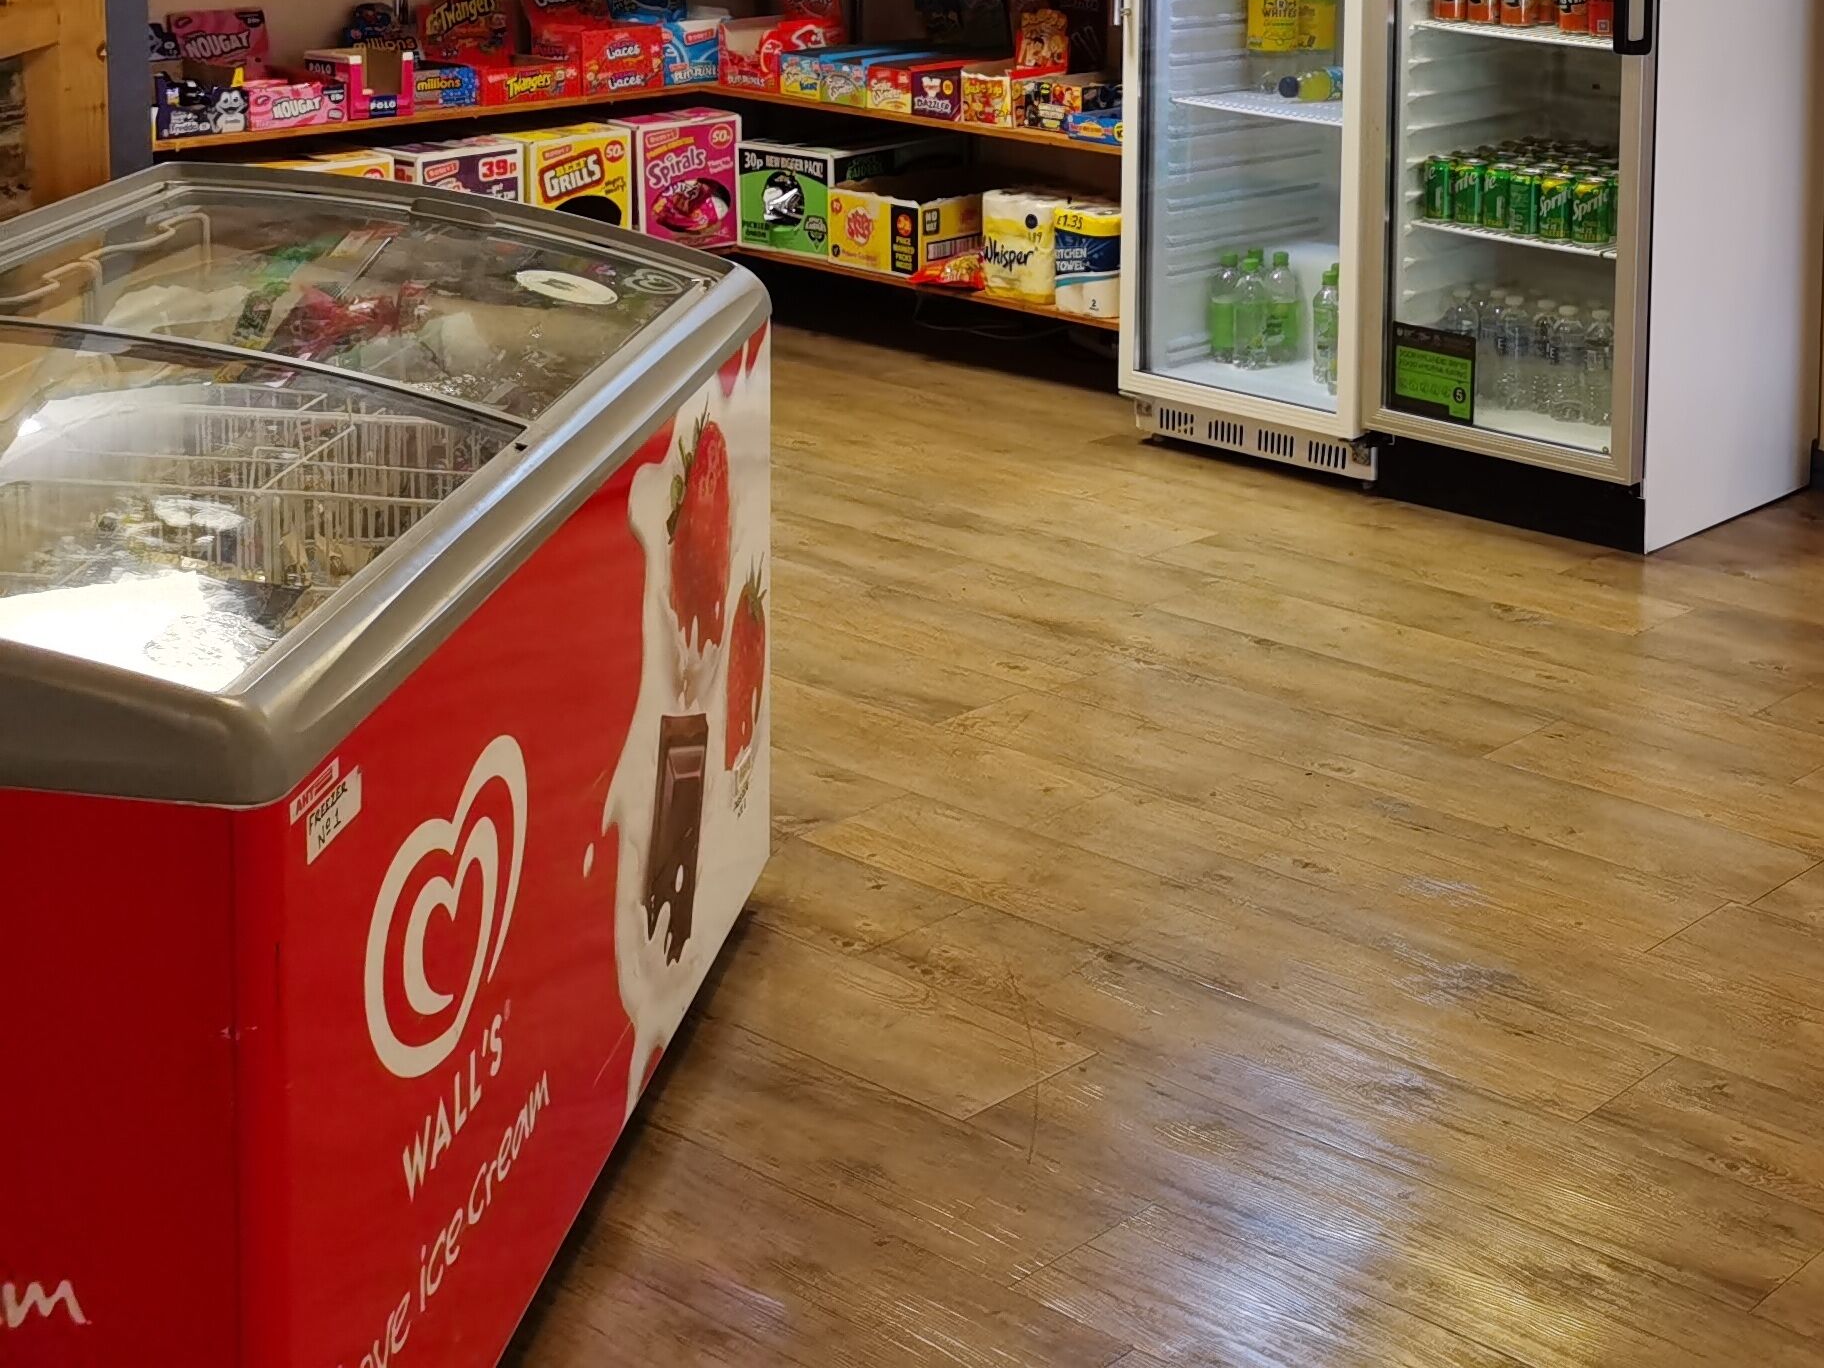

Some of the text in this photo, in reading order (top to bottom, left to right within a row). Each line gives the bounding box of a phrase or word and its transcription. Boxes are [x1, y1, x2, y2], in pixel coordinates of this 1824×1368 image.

[185, 31, 250, 59] NOUGAT
[353, 37, 417, 50] millions
[606, 44, 641, 60] Laces
[307, 63, 332, 74] POLO
[416, 78, 461, 91] millions
[507, 73, 551, 99] Twangers
[608, 75, 643, 91] Laces
[273, 97, 322, 120] NOUGAT
[915, 99, 951, 112] DAZZLER
[481, 158, 517, 179] 39p
[543, 153, 602, 198] GRILLS
[646, 145, 706, 189] Spirals
[744, 151, 764, 170] 30p
[765, 154, 780, 168] NEW
[780, 156, 804, 171] BIGGER
[804, 158, 824, 178] PACK!
[983, 234, 1034, 272] Whisper
[1056, 260, 1085, 272] TOWEL
[309, 781, 348, 835] FREEZER
[402, 1013, 504, 1204] WALL'S
[419, 1206, 464, 1313] ice
